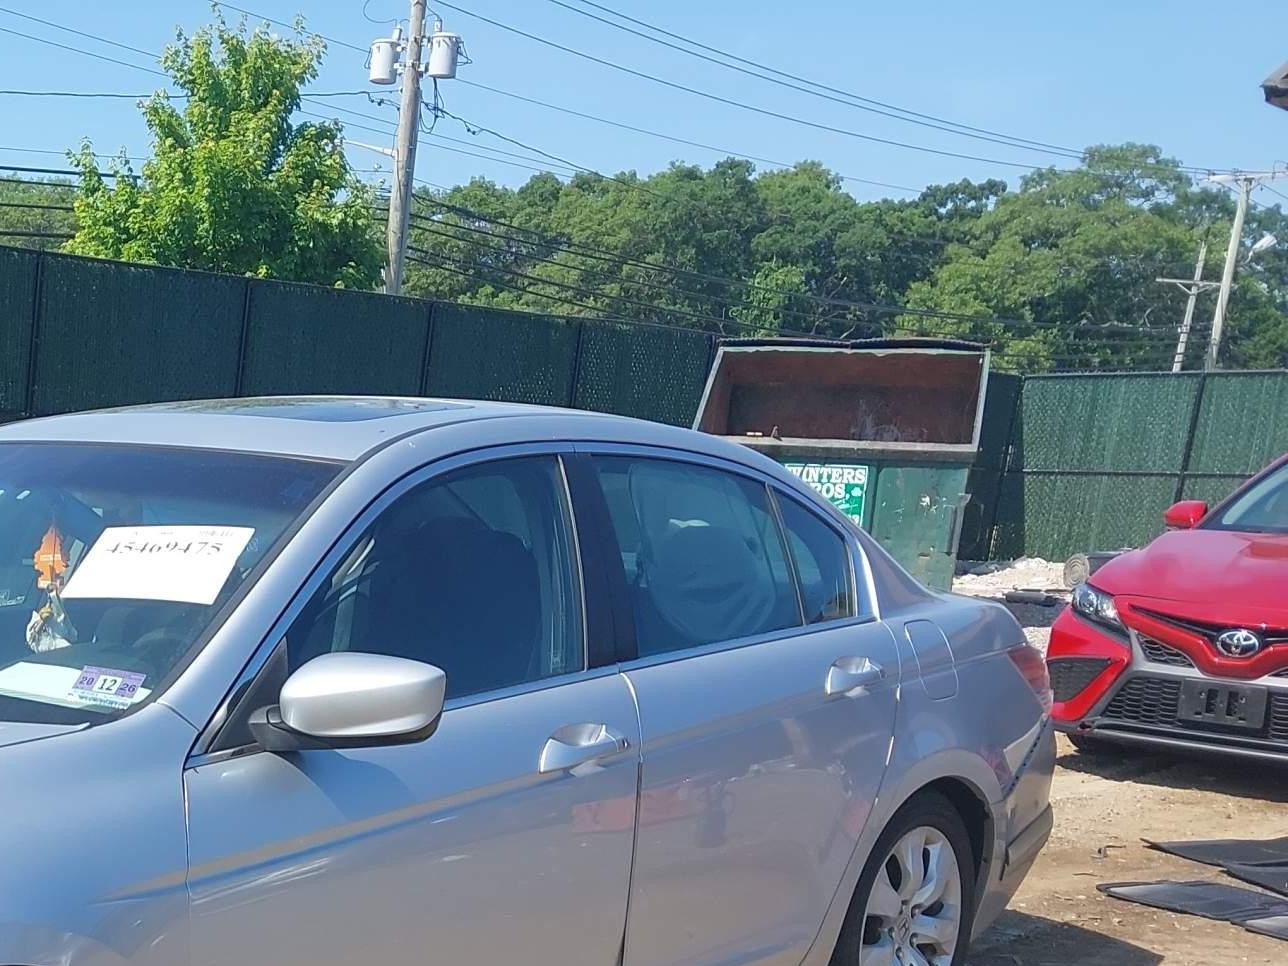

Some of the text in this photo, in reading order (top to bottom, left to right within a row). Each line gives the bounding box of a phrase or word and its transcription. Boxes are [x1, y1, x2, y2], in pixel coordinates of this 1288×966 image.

[79, 675, 137, 693] 20 12 26
